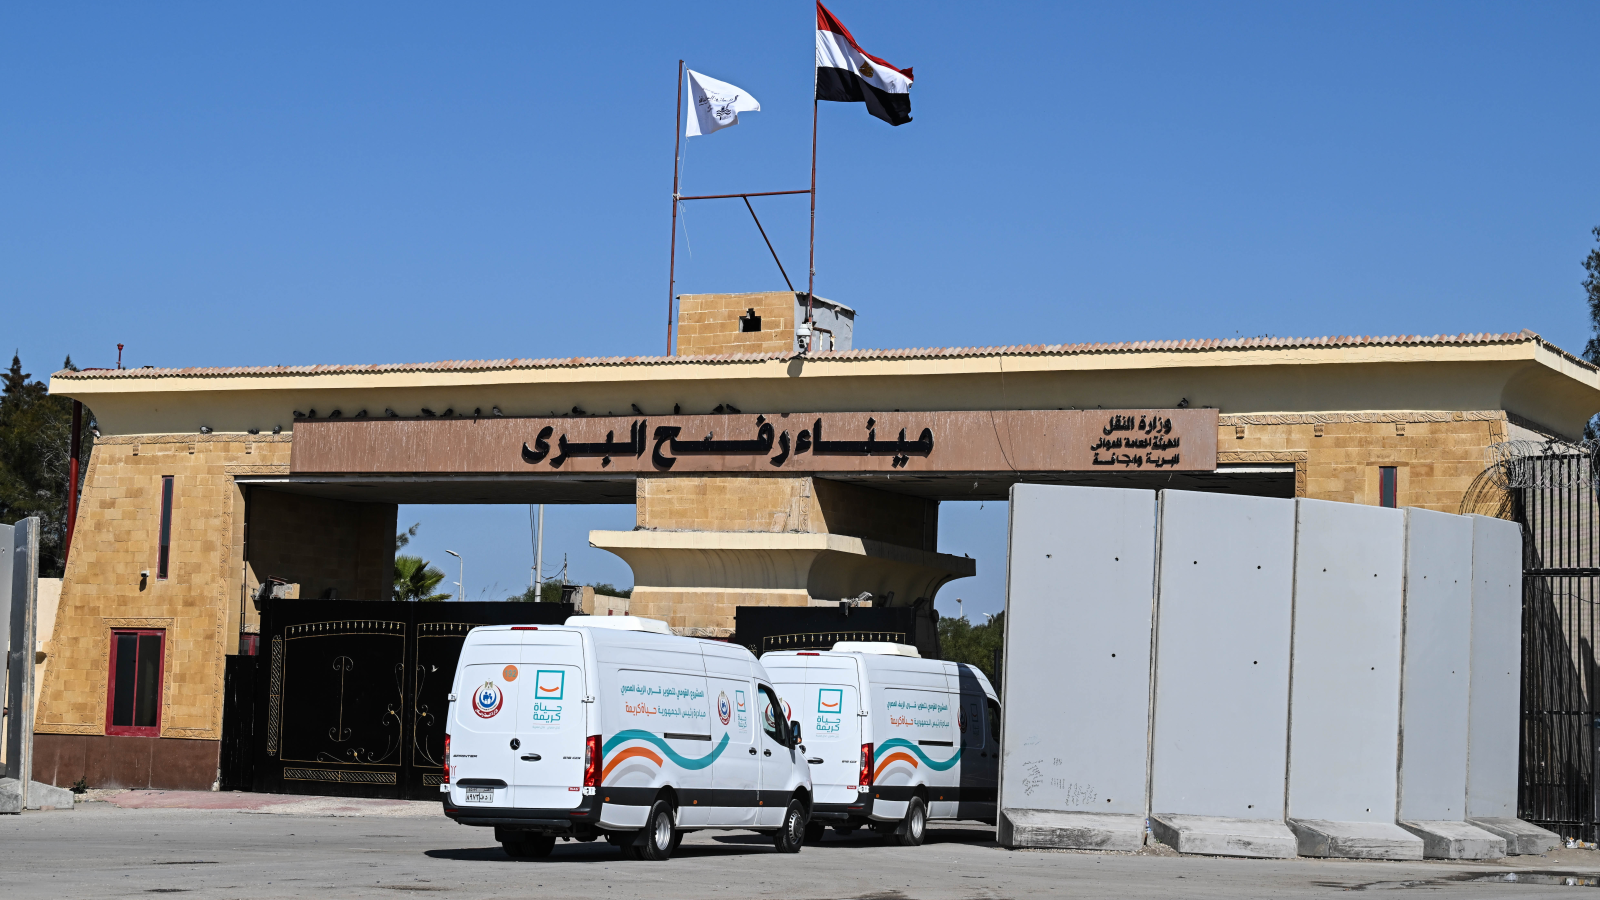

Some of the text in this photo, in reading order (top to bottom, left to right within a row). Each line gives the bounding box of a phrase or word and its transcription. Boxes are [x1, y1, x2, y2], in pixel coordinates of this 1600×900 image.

[1103, 414, 1172, 436] وزارة النقل
[652, 414, 791, 471] رفح
[794, 416, 934, 469] ميناء
[504, 669, 517, 678] 192
[533, 702, 562, 714] حياة
[533, 711, 561, 723] كريمة
